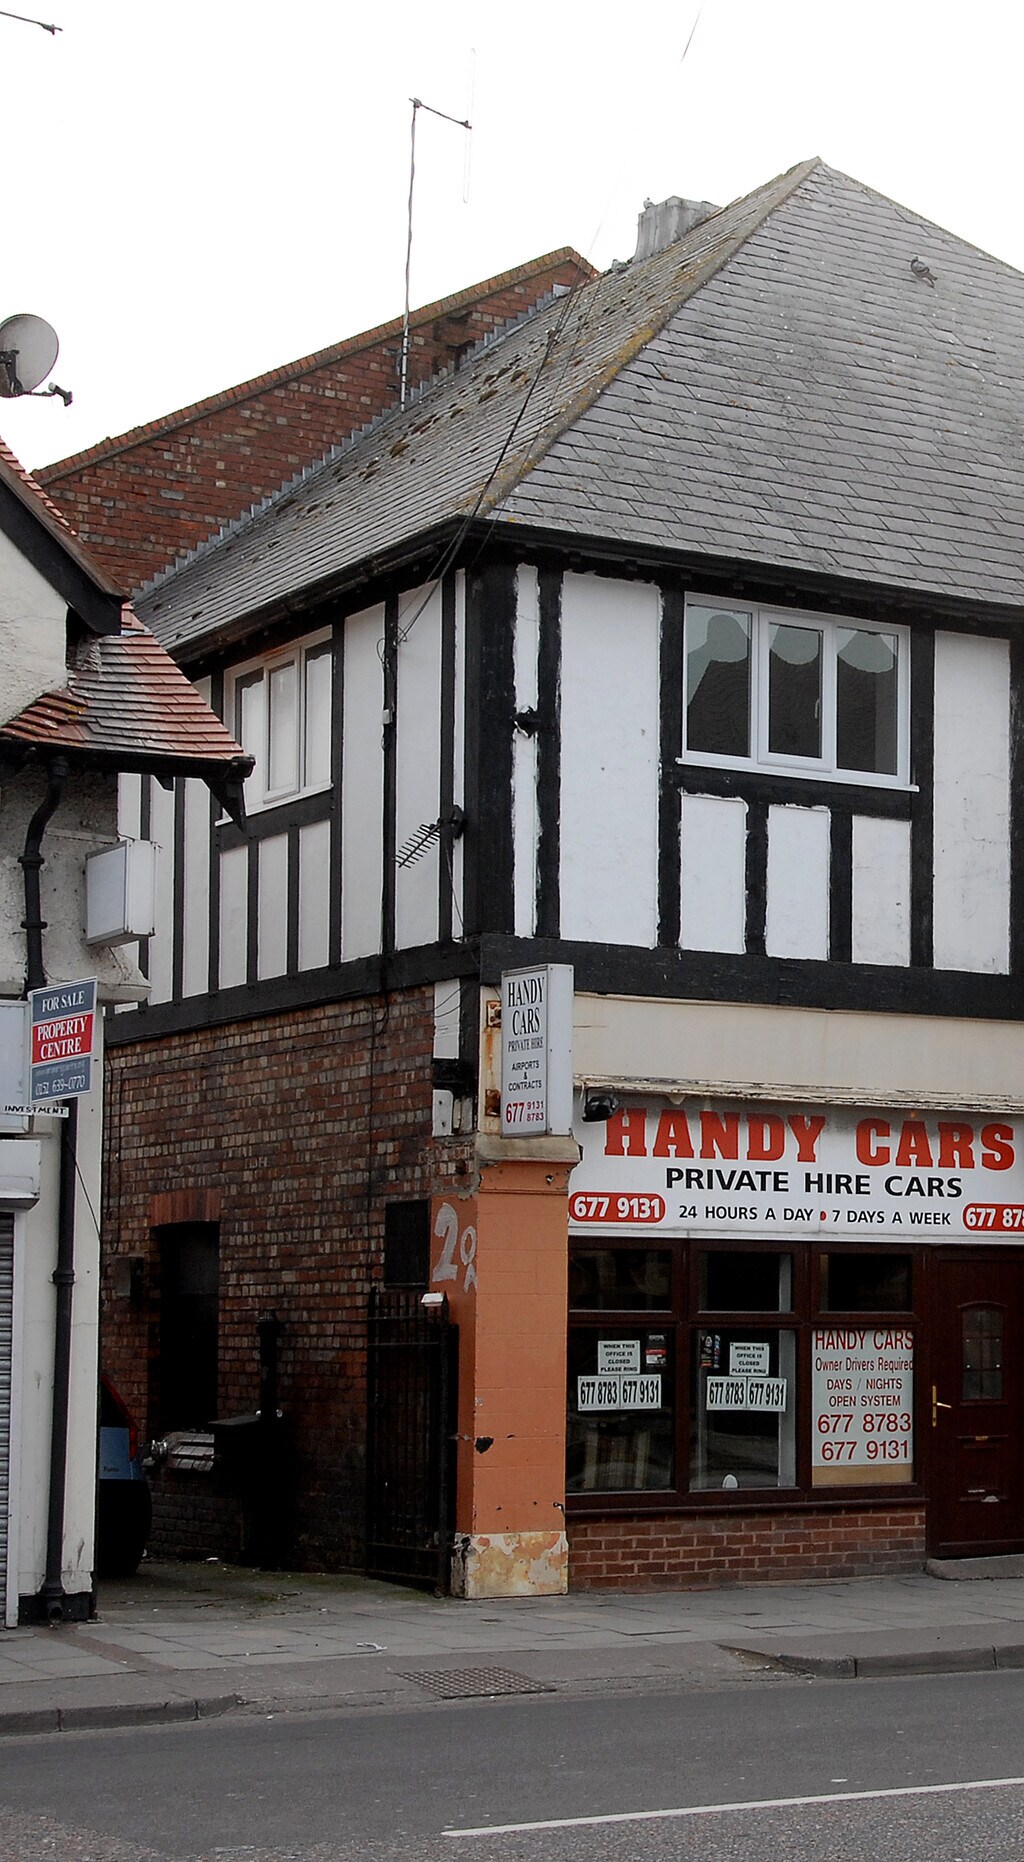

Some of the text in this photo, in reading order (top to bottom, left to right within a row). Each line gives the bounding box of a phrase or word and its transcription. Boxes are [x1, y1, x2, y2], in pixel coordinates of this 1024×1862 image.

[42, 990, 85, 1014] FOR SALE
[508, 977, 545, 1008] HANDY
[37, 1016, 88, 1042] PROPERTY
[512, 1007, 540, 1036] CARS
[40, 1036, 82, 1060] CENTRE
[508, 1036, 544, 1053] PRIVATE HIRE
[511, 1060, 540, 1071] AIRPORTS
[523, 1072, 528, 1080] &
[508, 1080, 542, 1092] CONTRACTS
[5, 1105, 65, 1115] INVESTMENT
[506, 1101, 544, 1124] 677 9131
[526, 1111, 544, 1122] 8783
[604, 1107, 1015, 1170] HANDY CARS
[666, 1167, 963, 1198] PRIVATE HIRE CARS
[573, 1196, 661, 1220] 677 9131
[678, 1205, 951, 1225] 24 HOURS A DAY 7 DAYS A WEEK
[966, 1206, 998, 1228] 677
[815, 1330, 914, 1350] HANDY CARS
[815, 1357, 842, 1371] Owner
[846, 1357, 875, 1371] Drivers
[580, 1379, 659, 1404] 677 8783 677 9131
[709, 1382, 784, 1406] 677 8783 677 9131
[827, 1379, 852, 1390] DAYS
[866, 1378, 903, 1390] NIGHTS
[829, 1395, 901, 1407] OPEN SYSTEM
[818, 1413, 912, 1433] 677 8783
[821, 1440, 909, 1461] 677 9131
